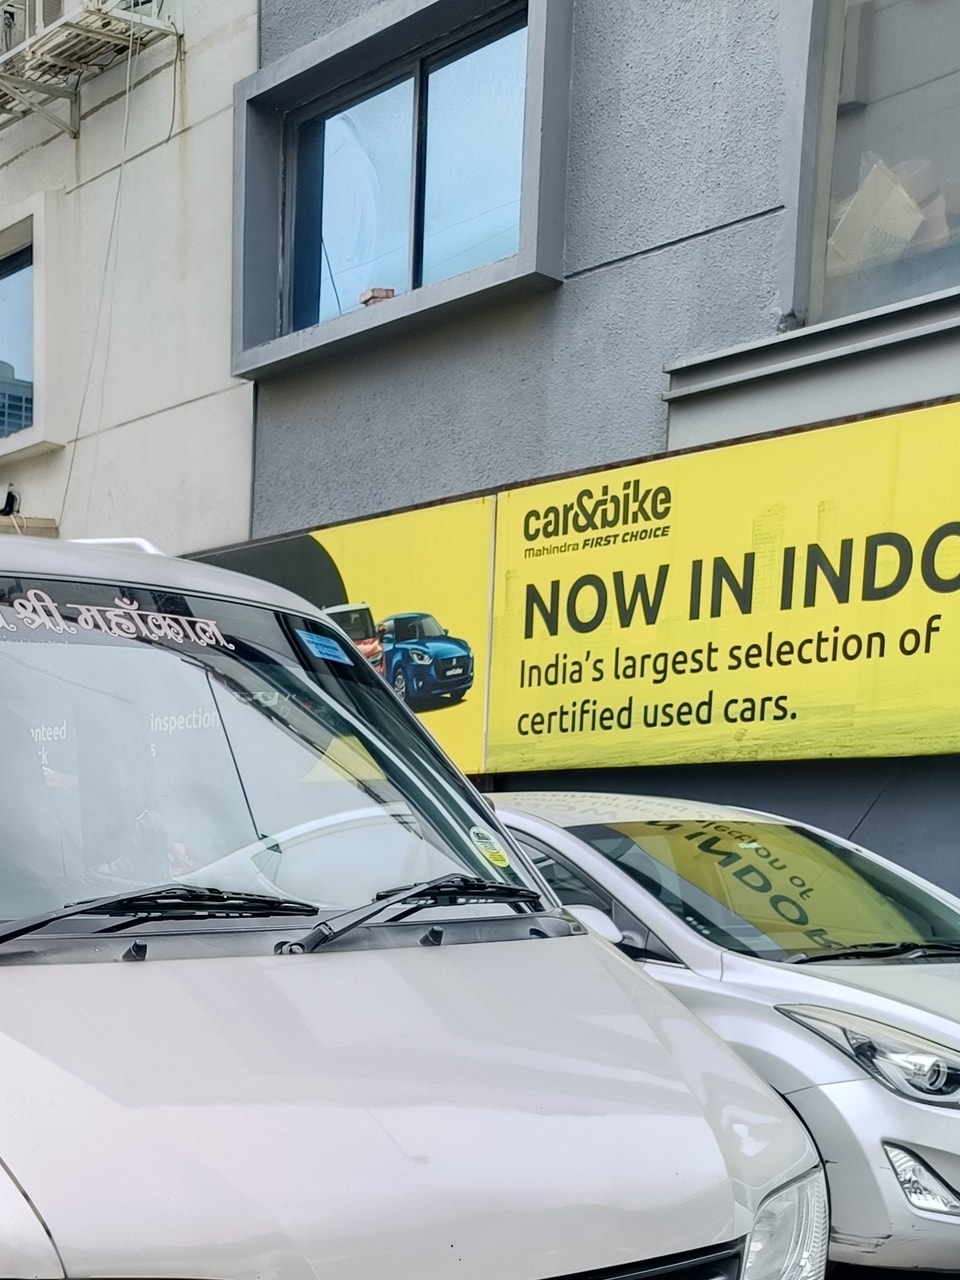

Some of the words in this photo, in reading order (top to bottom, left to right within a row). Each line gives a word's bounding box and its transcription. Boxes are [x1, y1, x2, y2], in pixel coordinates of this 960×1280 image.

[523, 479, 671, 542] car&bike
[523, 542, 579, 559] Mahindra
[582, 534, 620, 551] FIRST
[621, 525, 671, 543] CHOICE
[13, 589, 77, 635] श्री
[523, 564, 670, 640] NOW
[688, 552, 755, 621] IN
[519, 649, 605, 689] India's
[613, 641, 718, 685] largest
[728, 625, 885, 671] selection
[899, 614, 941, 656] of
[517, 696, 633, 736] certified
[643, 690, 714, 728] used
[724, 694, 798, 724] cars.
